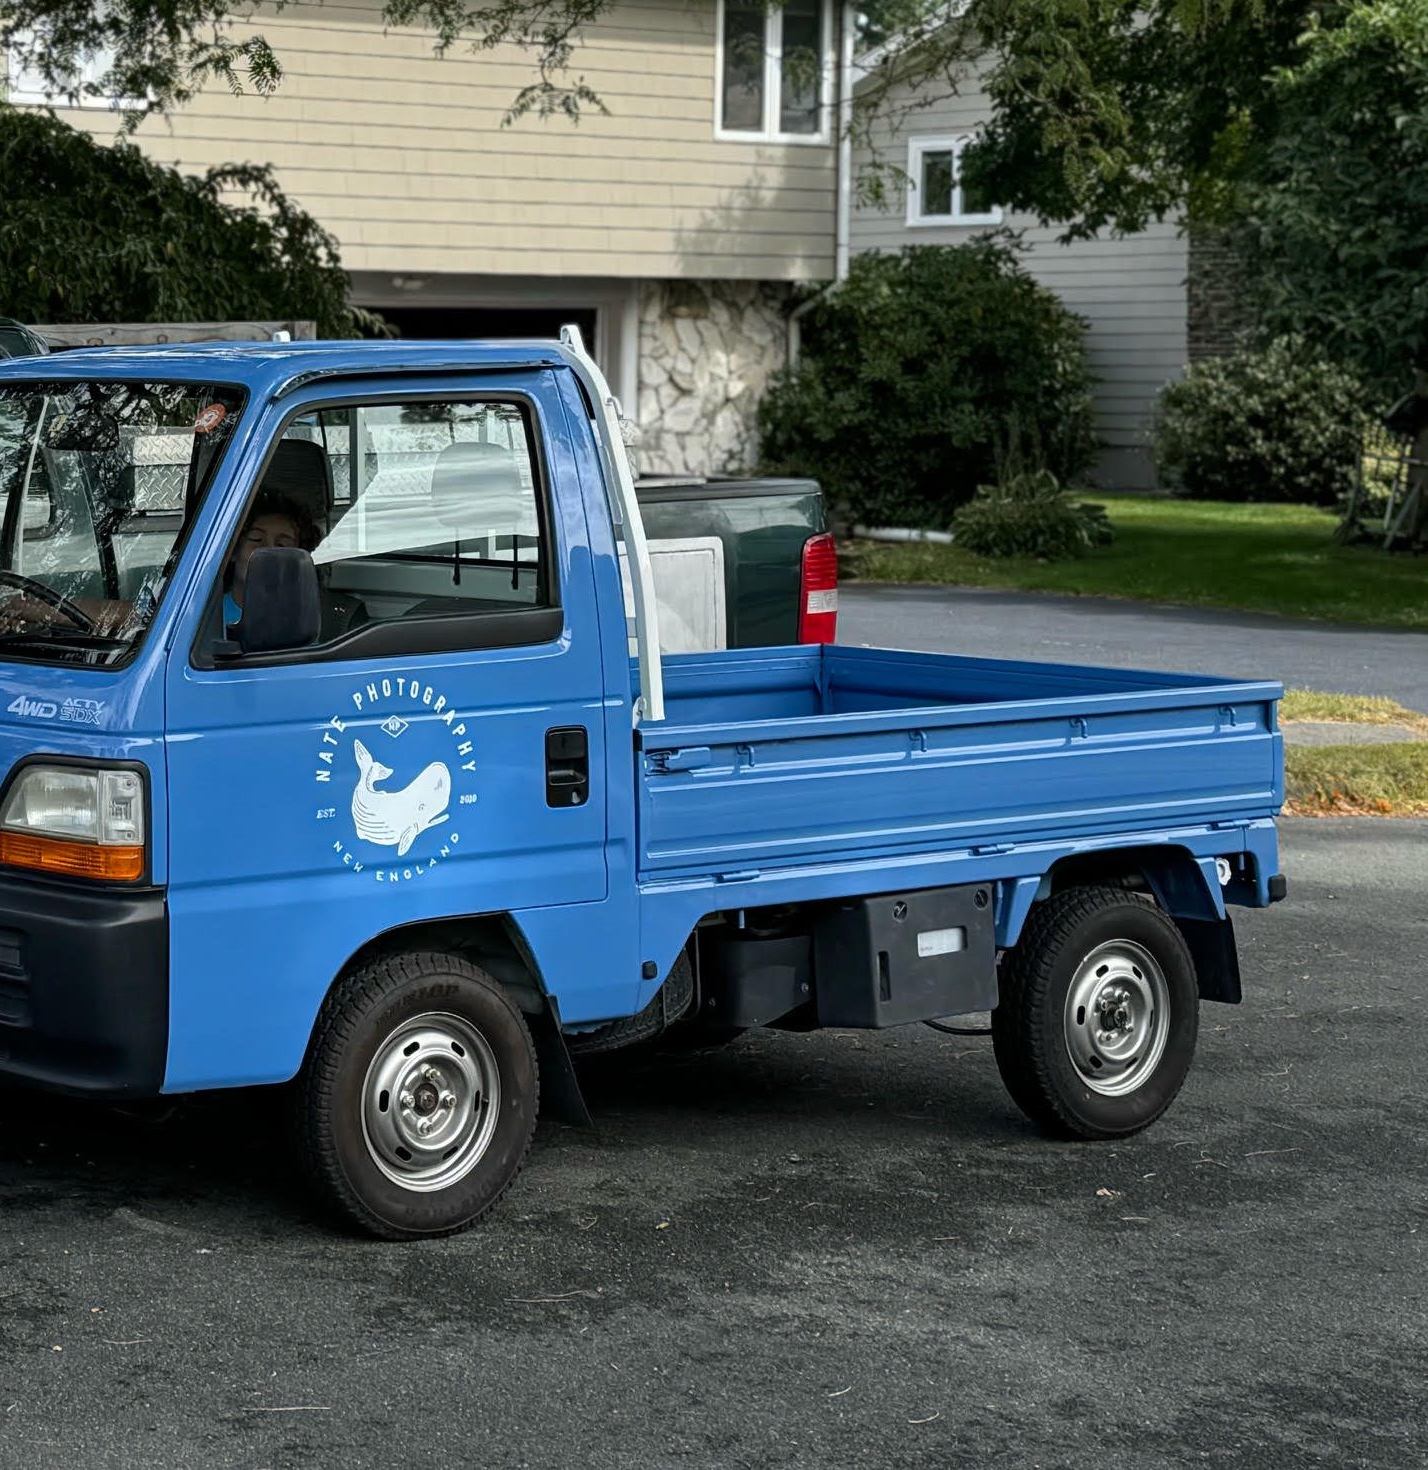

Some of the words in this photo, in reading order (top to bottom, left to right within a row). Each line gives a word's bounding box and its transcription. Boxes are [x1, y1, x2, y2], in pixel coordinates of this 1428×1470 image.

[7, 695, 57, 719] 4WD
[62, 697, 105, 710] ACTY
[60, 707, 103, 725] SDX
[316, 715, 347, 782] NATE
[352, 678, 476, 772] PHOTOGRAPHY
[316, 807, 336, 819] EST.
[333, 840, 364, 873] NEW
[375, 833, 459, 882] ENGLAND
